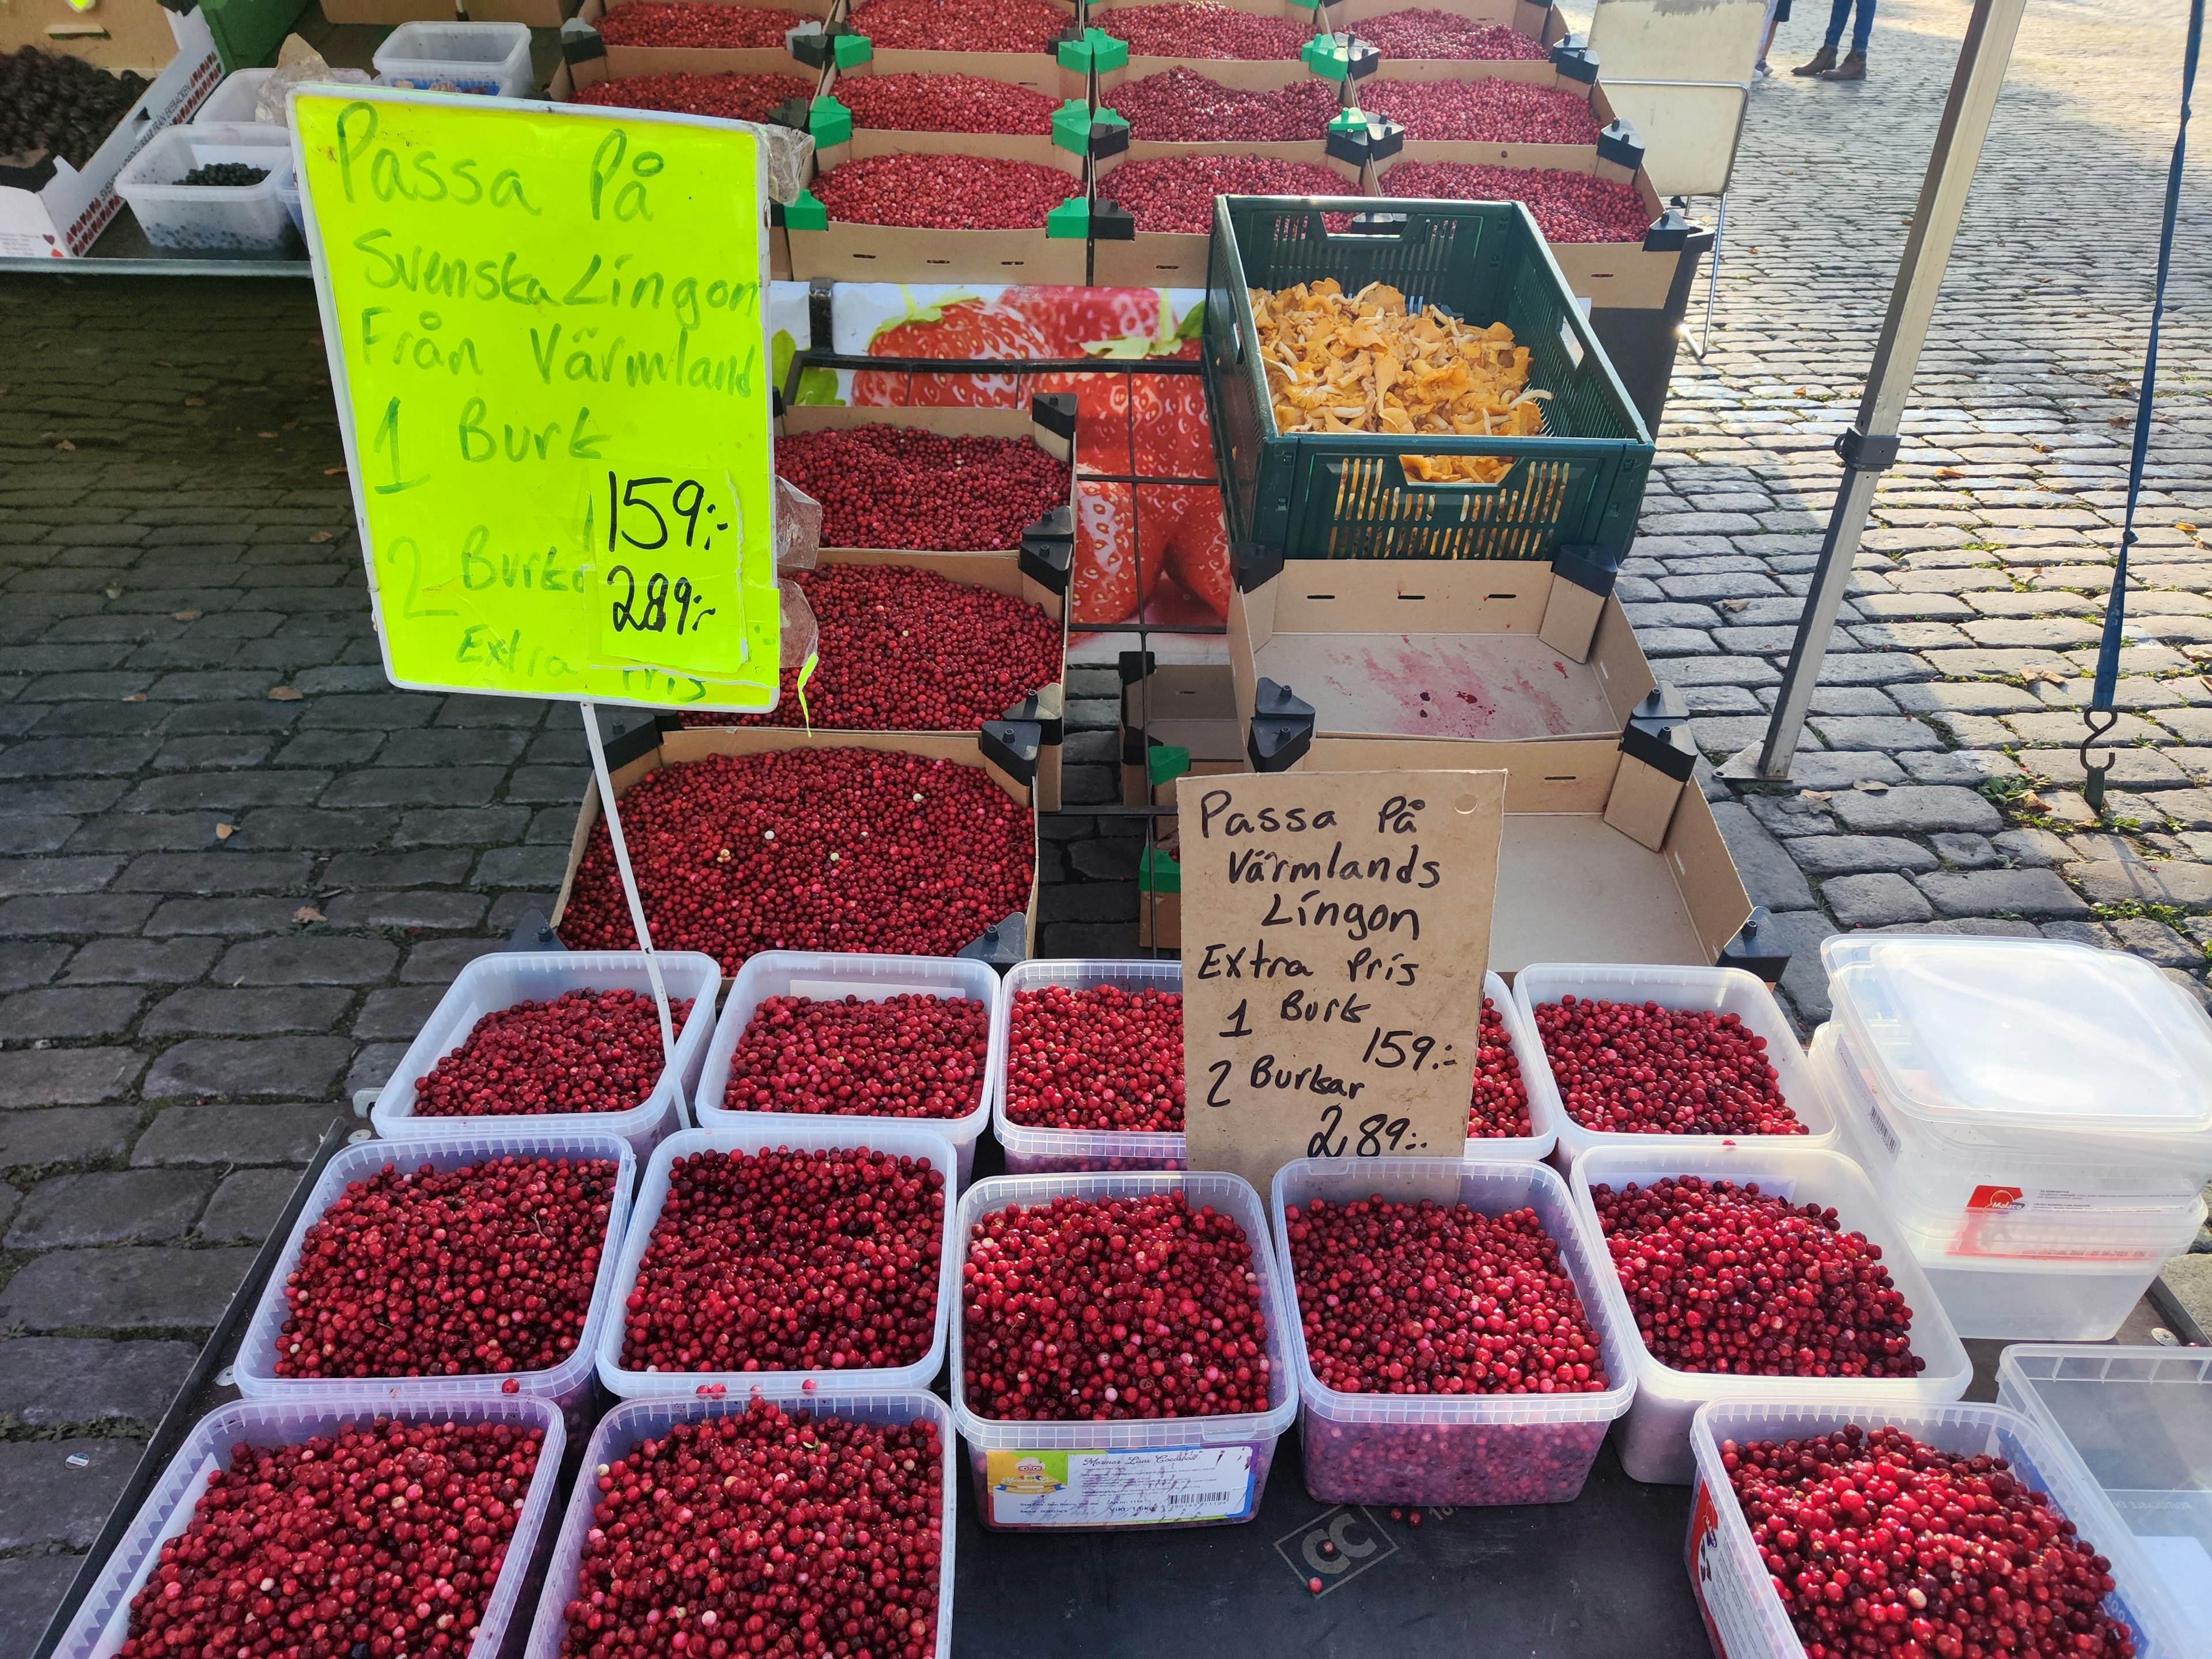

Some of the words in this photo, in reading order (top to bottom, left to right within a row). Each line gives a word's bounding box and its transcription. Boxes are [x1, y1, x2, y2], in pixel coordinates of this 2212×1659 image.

[336, 101, 541, 217] Passa
[589, 128, 666, 223] På
[354, 228, 562, 308] Svenska
[563, 252, 760, 331] Lingon
[361, 307, 484, 376] Från
[529, 323, 756, 399] Värmland
[373, 396, 432, 495] 1
[459, 396, 614, 462] Burk
[387, 536, 459, 620] 2
[456, 624, 579, 679] Extra
[1200, 790, 1338, 839] Passa
[1377, 796, 1426, 834] På
[1229, 841, 1441, 889] Värmlands
[1260, 889, 1420, 941] Lingon
[1198, 939, 1314, 980] Extra
[1347, 947, 1420, 986] Pris
[1219, 998, 1253, 1038] 1
[1281, 989, 1372, 1023] Burk
[1207, 1059, 1233, 1108] 2
[1249, 1054, 1366, 1100] Burkar
[1991, 1201, 2022, 1210] Malaco
[1001, 1476, 1033, 1484] Mormor
[1082, 1457, 1121, 1467] Mormor
[1125, 1456, 1152, 1464] Lisas
[1301, 1513, 1378, 1574] CC
